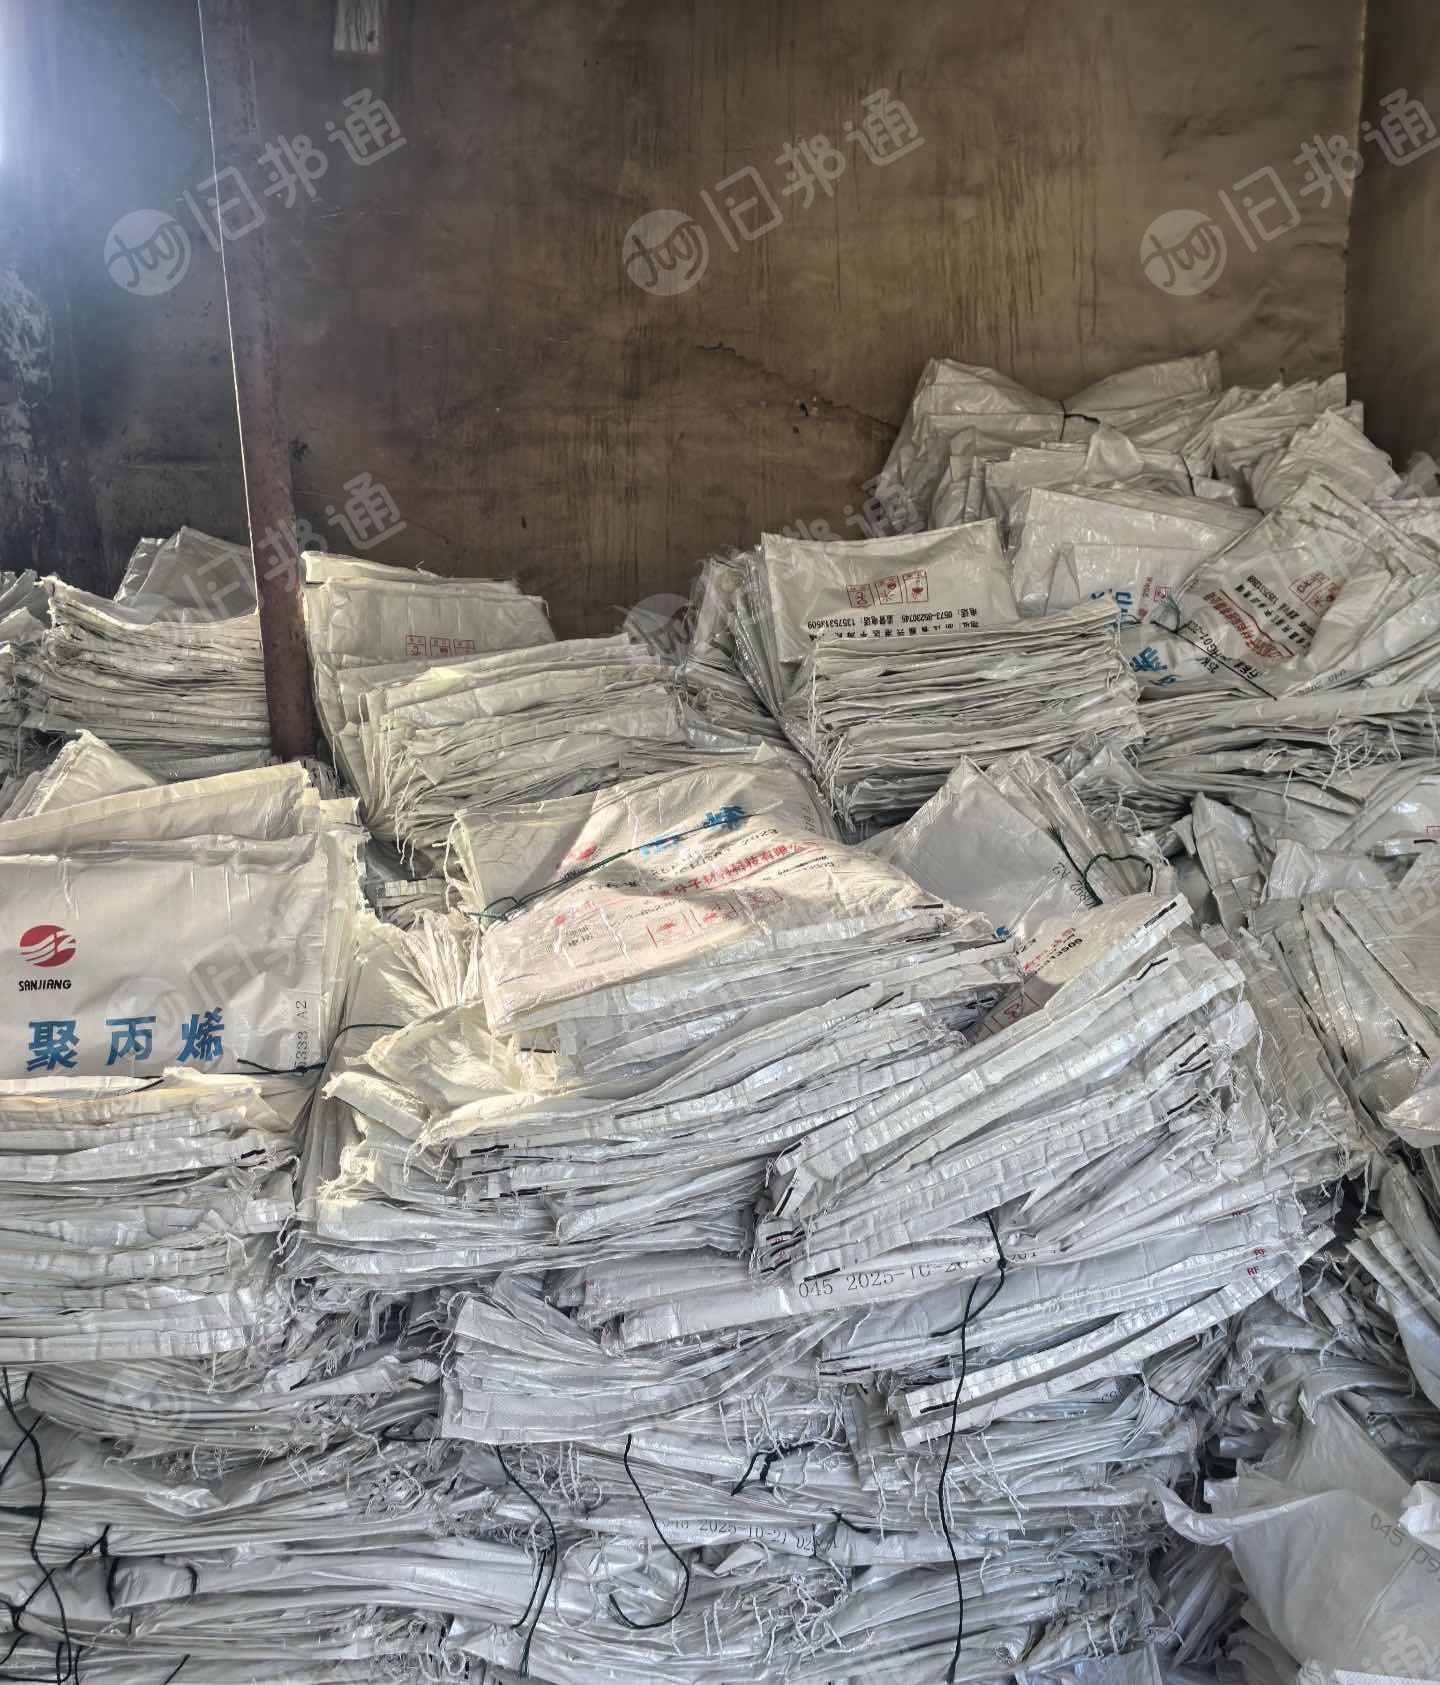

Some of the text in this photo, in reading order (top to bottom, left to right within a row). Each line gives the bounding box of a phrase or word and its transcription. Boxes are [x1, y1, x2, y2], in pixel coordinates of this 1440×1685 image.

[18, 979, 72, 992] SANJIANG
[26, 1006, 225, 1072] 聚丙烯
[798, 1279, 834, 1298] 045
